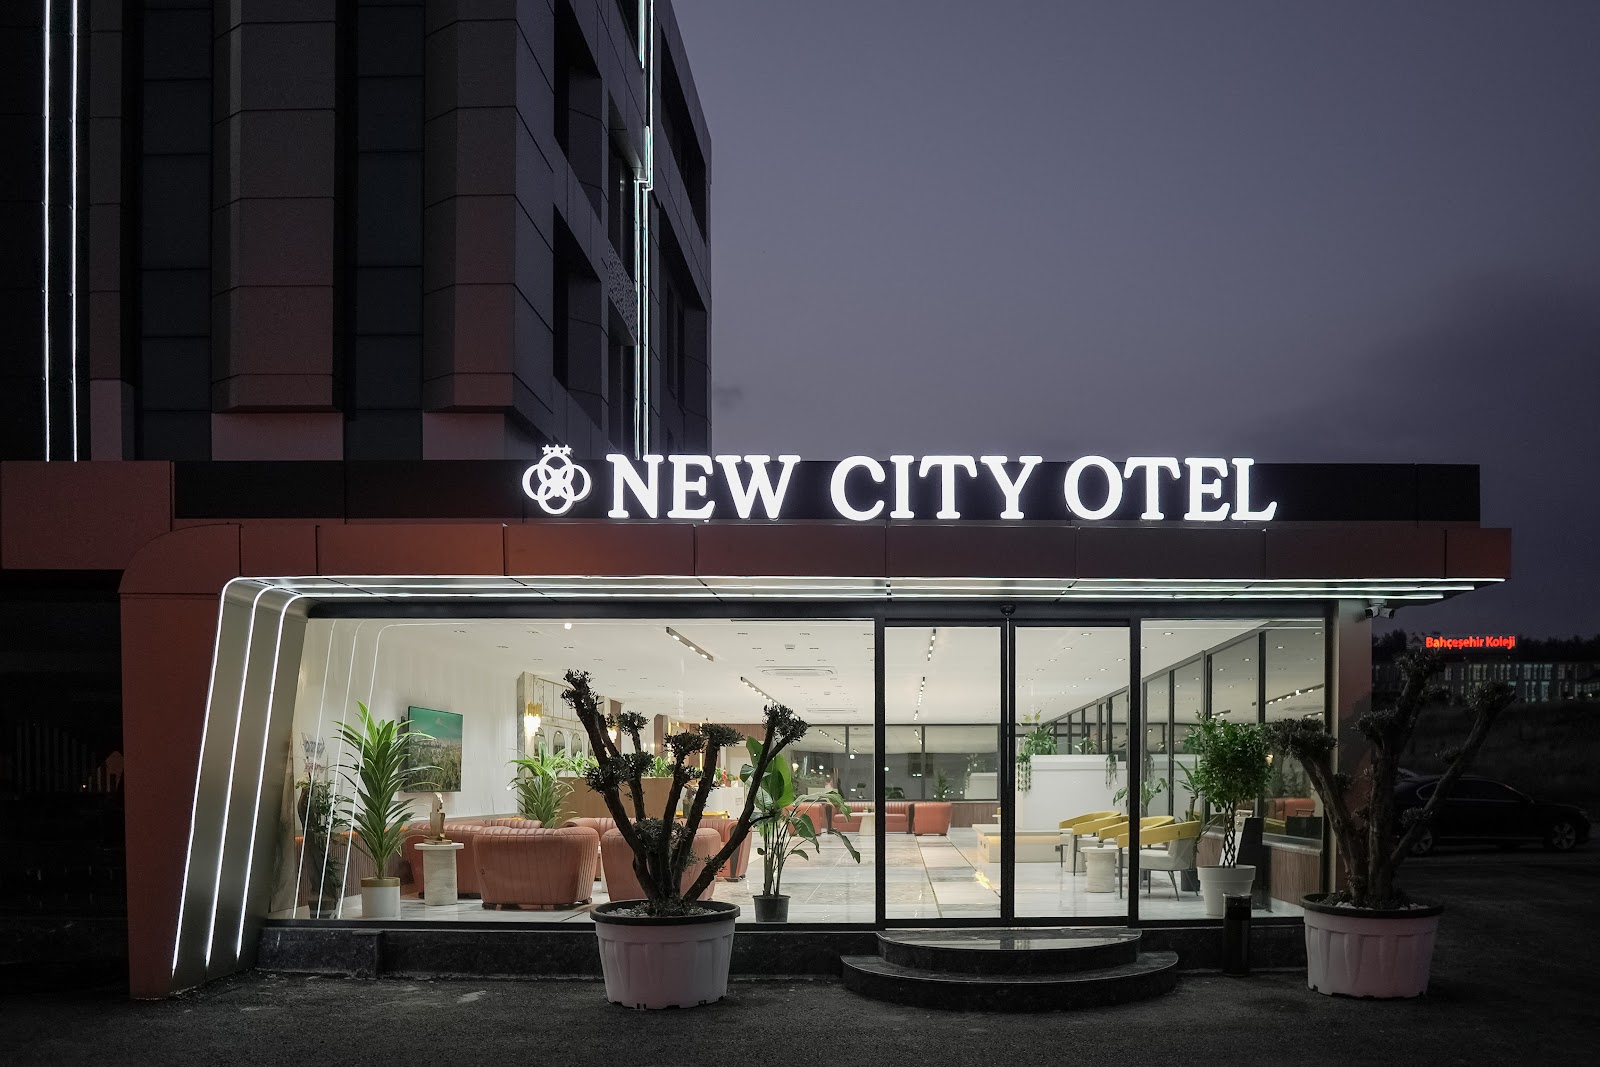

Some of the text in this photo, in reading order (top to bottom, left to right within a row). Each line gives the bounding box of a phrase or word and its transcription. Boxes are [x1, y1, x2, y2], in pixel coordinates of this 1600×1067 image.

[606, 453, 1277, 522] NEW CITY OTEL
[1425, 635, 1515, 650] Bahçeşehir Koleji
